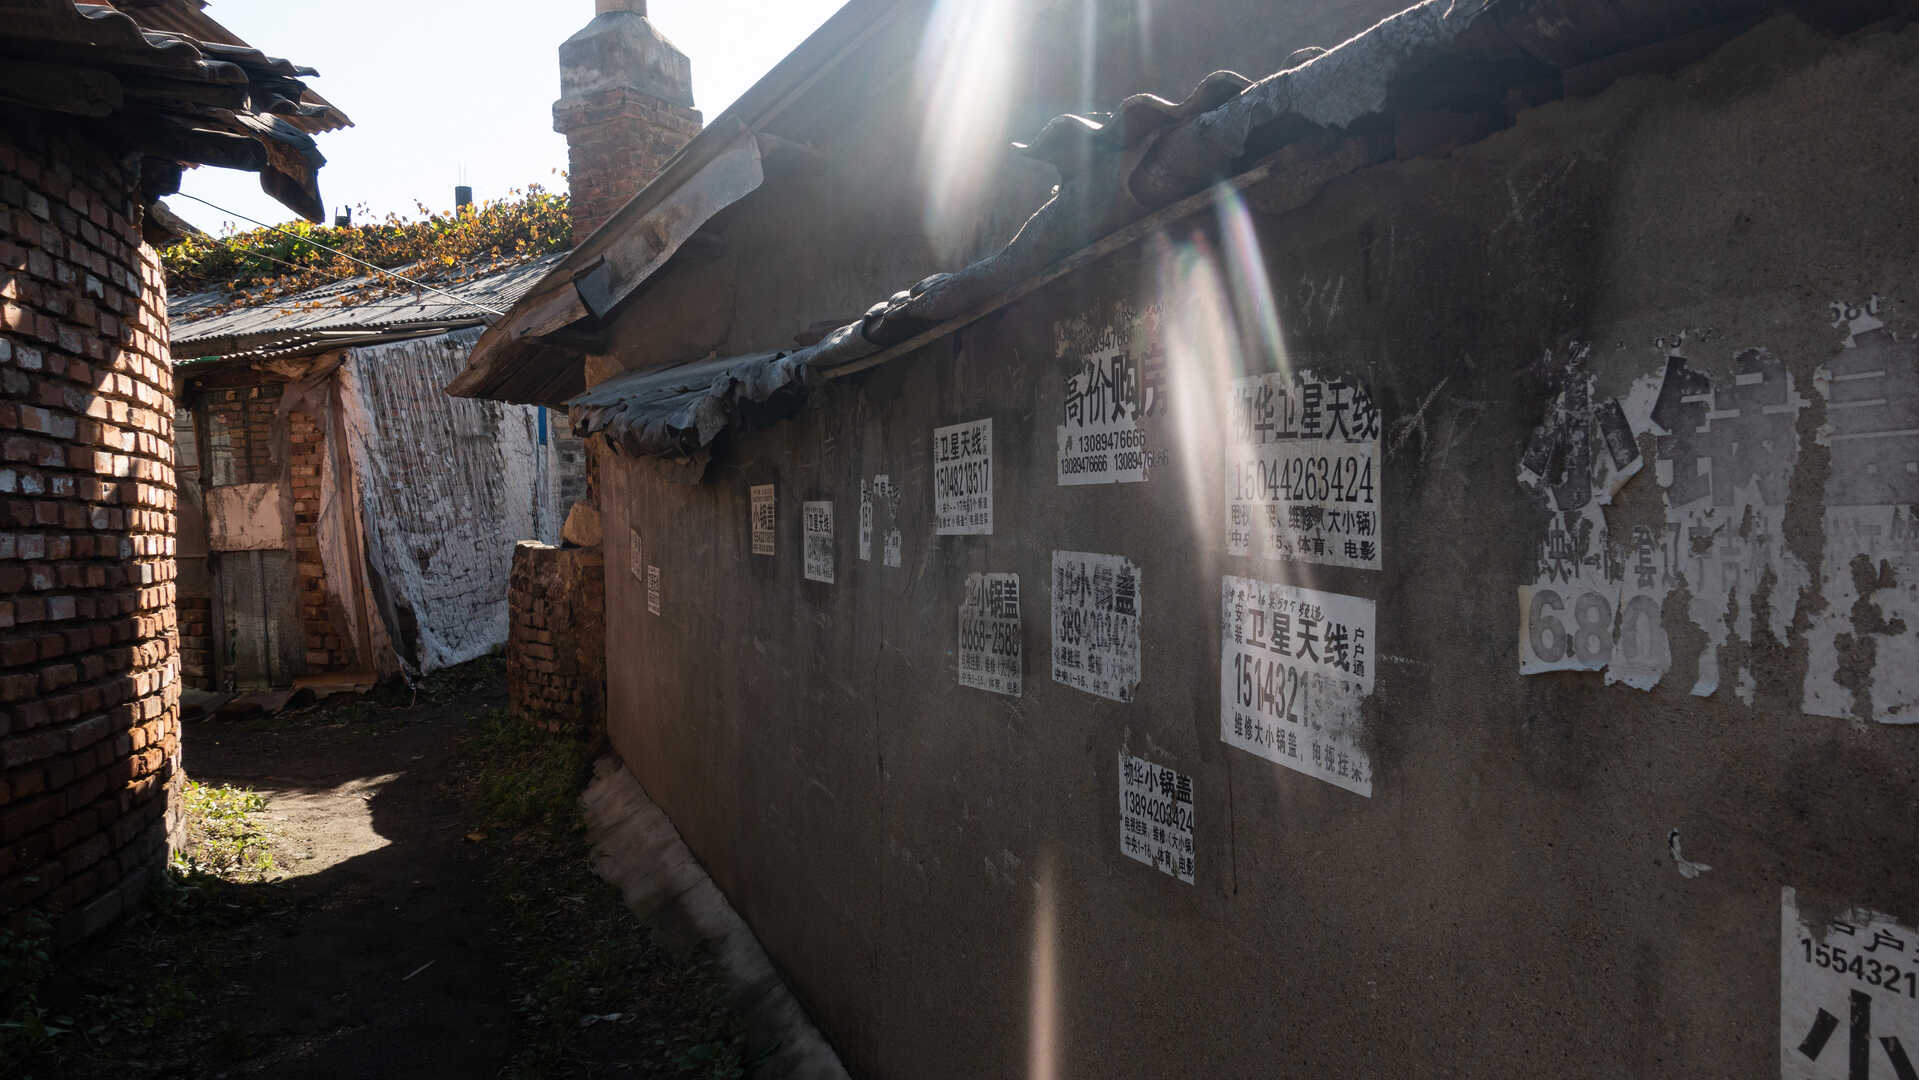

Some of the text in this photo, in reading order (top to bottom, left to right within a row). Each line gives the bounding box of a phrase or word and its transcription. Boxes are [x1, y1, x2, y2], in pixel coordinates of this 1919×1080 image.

[940, 426, 981, 461] 卫星天线
[1078, 430, 1146, 453] 13089476666
[935, 458, 988, 498] 15048213517
[1234, 456, 1375, 503] 15044263424
[1246, 609, 1351, 673] 卫星天线
[1352, 626, 1366, 678] 户户通
[1123, 791, 1194, 836] 13894203424
[1801, 937, 1917, 999] 1554321
